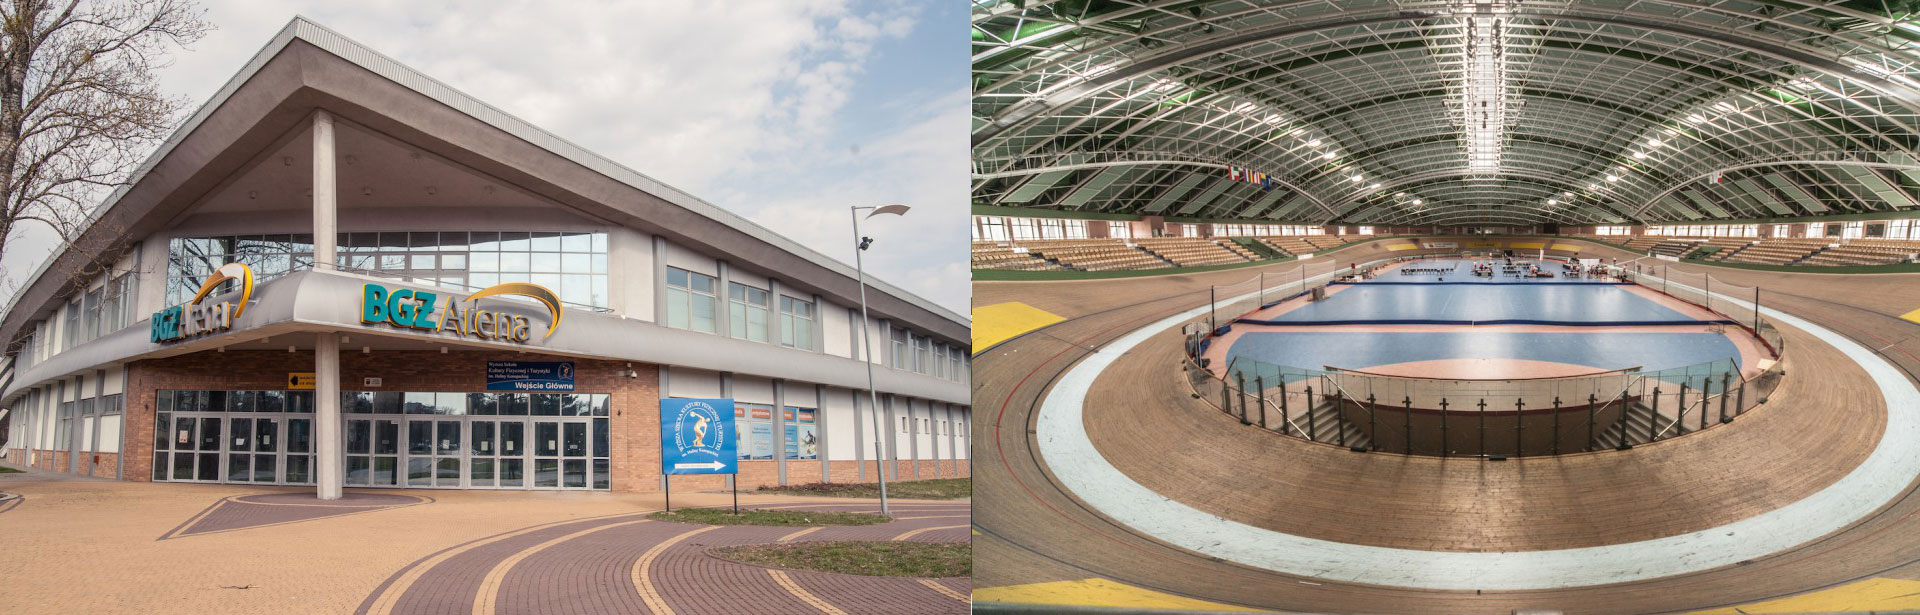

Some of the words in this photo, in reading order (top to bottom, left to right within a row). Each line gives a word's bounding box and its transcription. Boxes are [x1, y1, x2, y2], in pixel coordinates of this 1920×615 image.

[437, 296, 531, 342] Arena
[515, 382, 544, 390] Wejście
[546, 382, 573, 390] Główne
